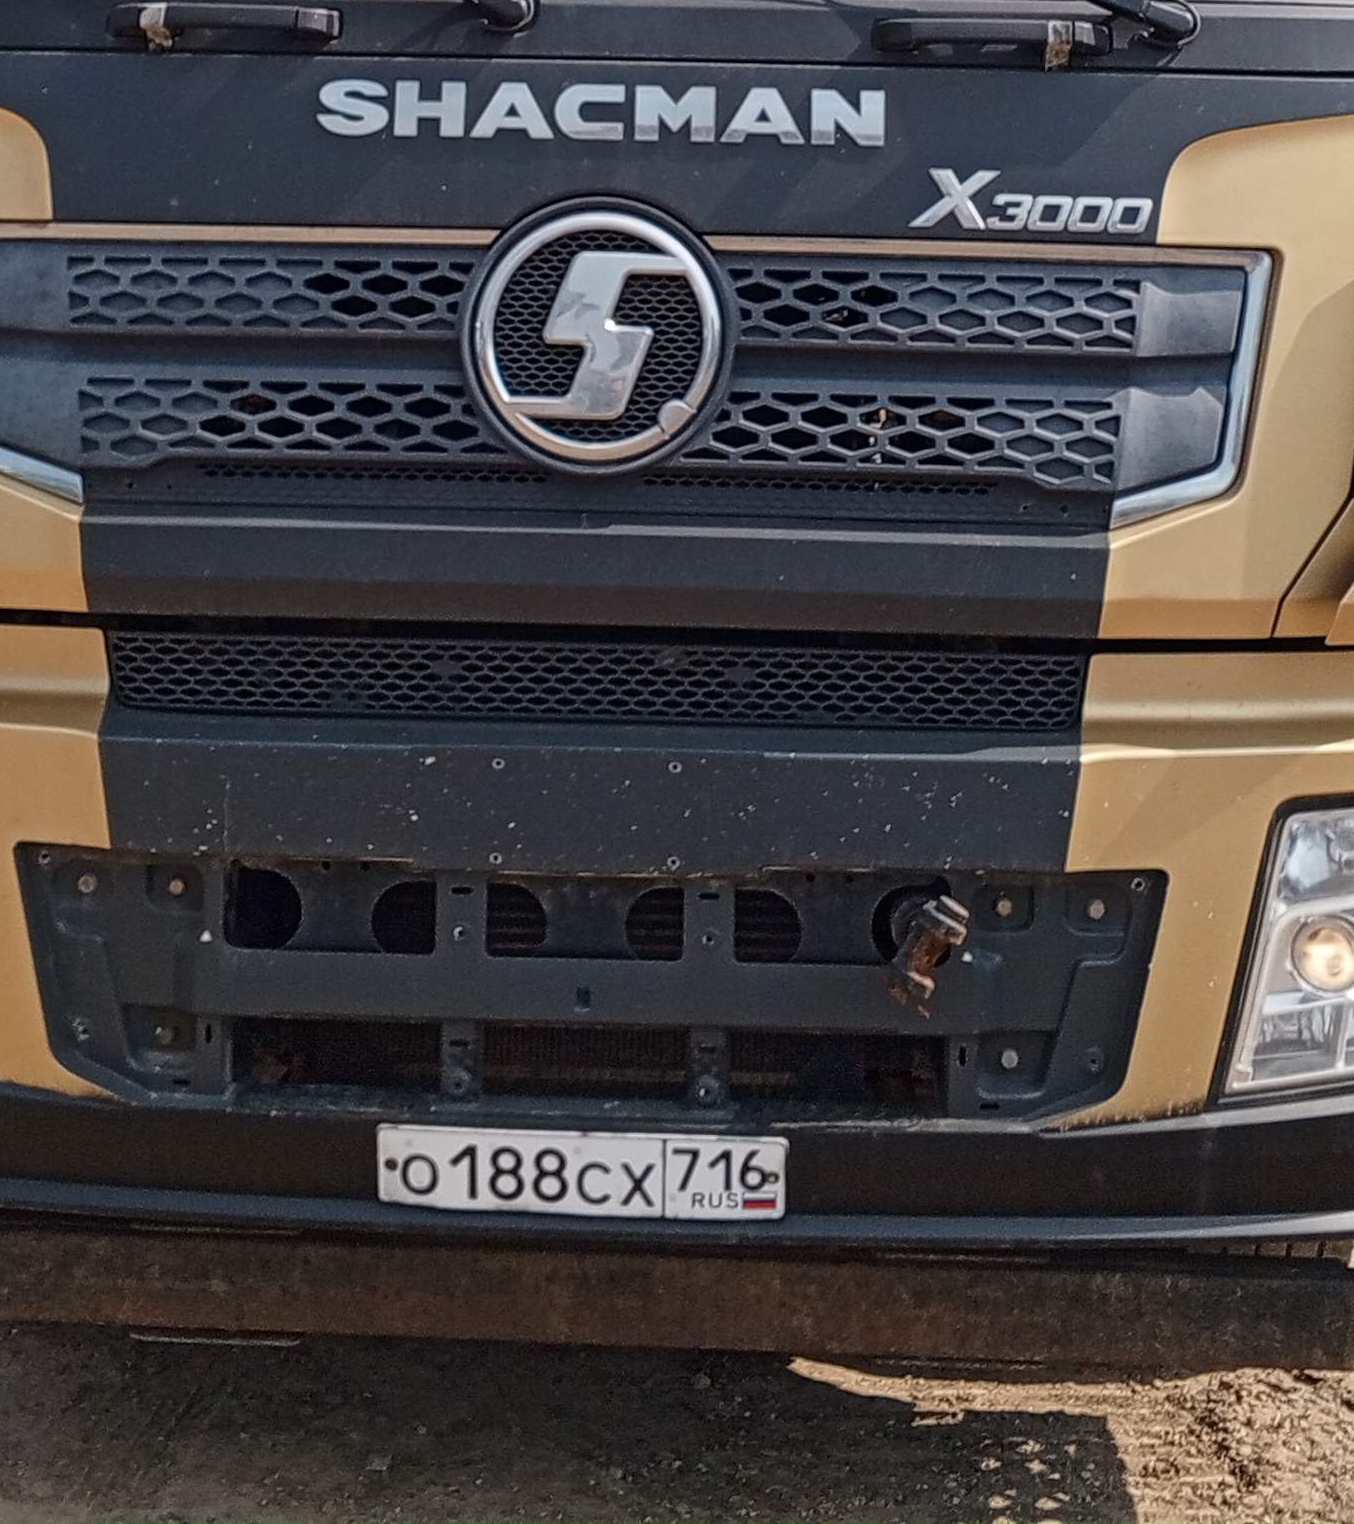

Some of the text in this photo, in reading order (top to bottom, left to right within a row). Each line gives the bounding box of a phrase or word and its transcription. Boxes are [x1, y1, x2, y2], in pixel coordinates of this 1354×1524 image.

[315, 79, 886, 146] SHACMAN
[908, 167, 1154, 234] X3000
[671, 1147, 768, 1193] 716
[691, 1191, 739, 1209] RUS
